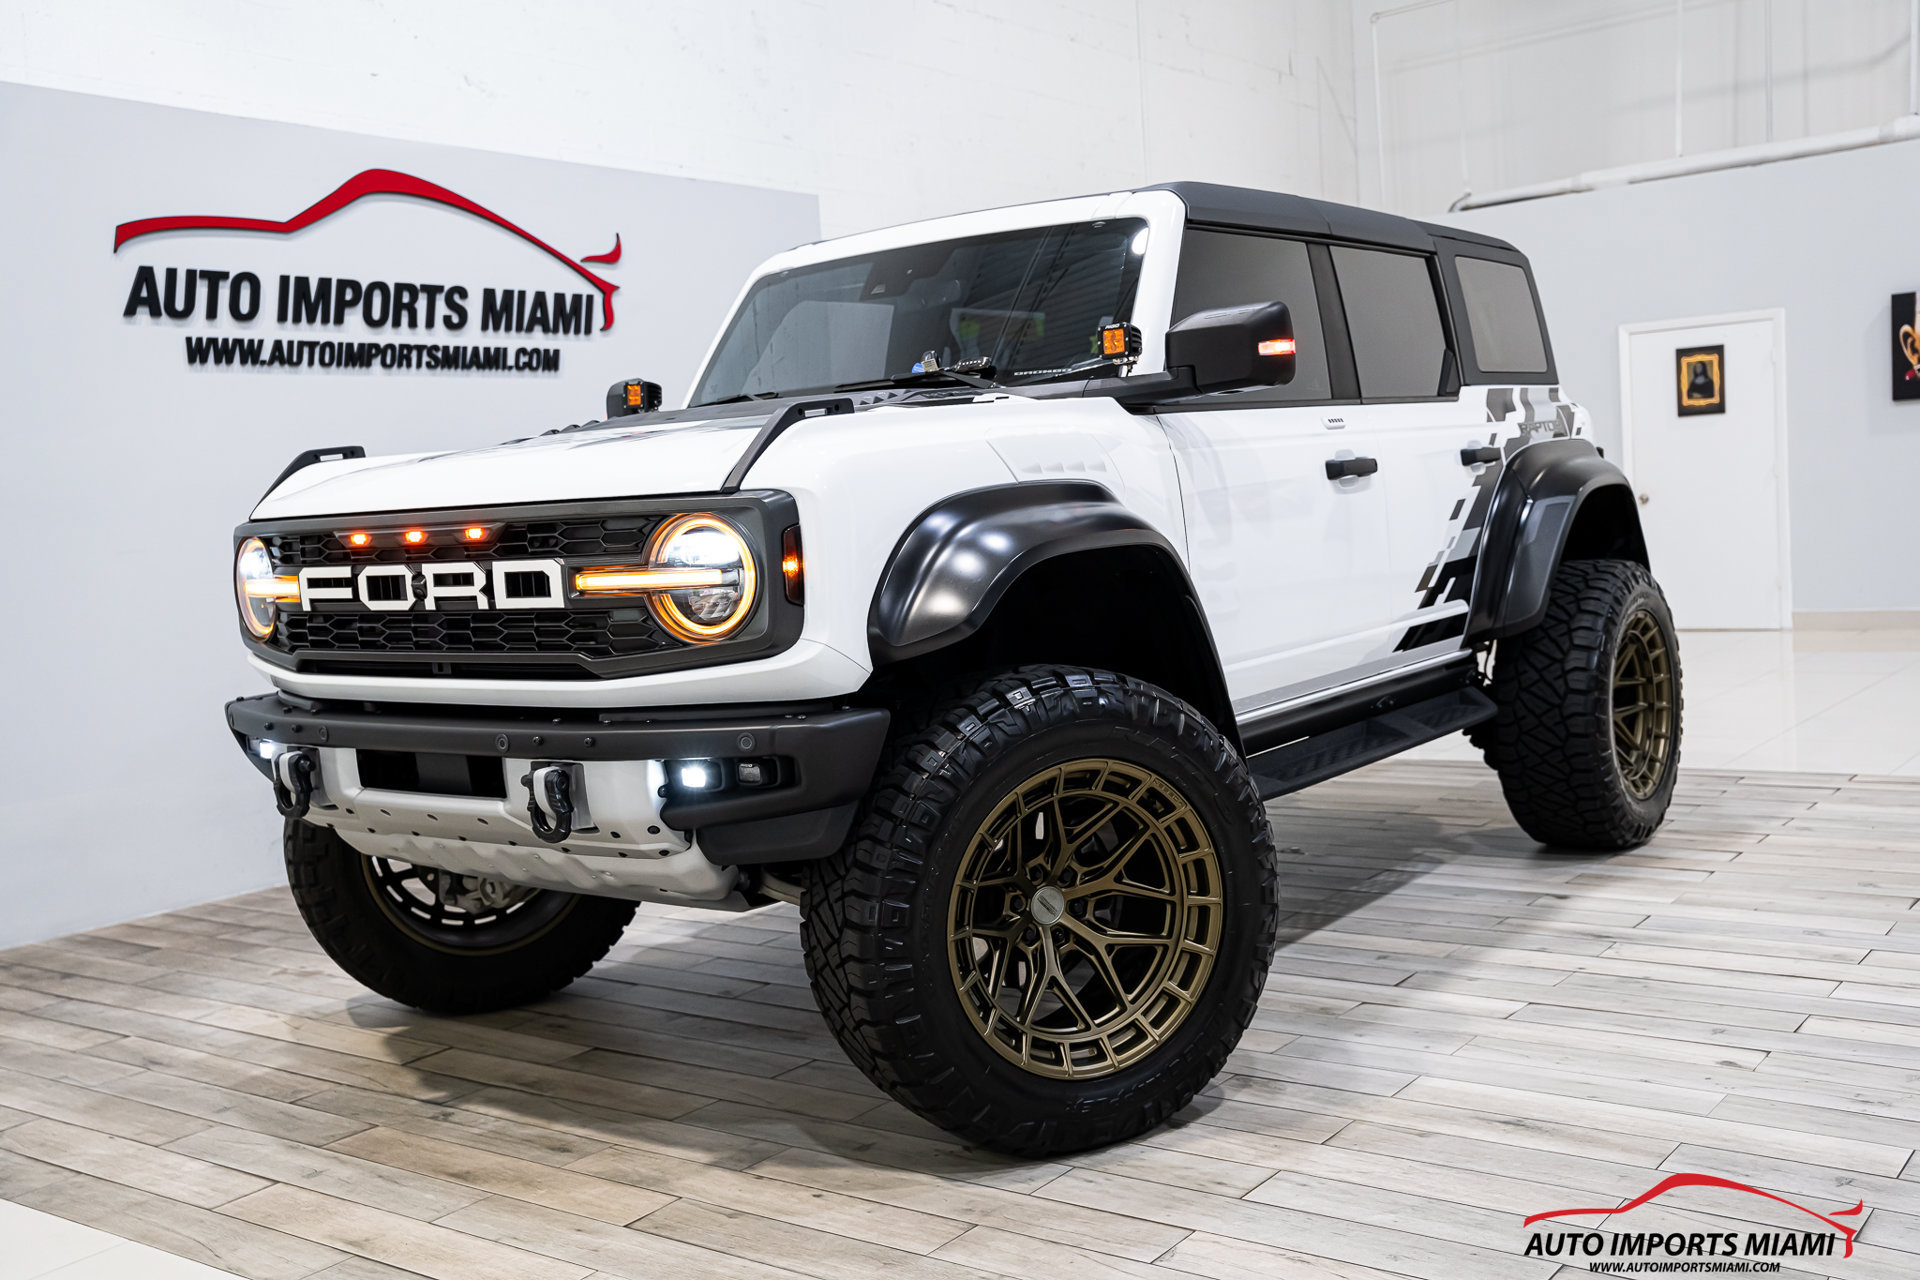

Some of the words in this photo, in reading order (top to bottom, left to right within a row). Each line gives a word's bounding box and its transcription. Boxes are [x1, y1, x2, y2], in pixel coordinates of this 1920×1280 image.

[124, 265, 261, 323] AUTO
[277, 274, 469, 331] IMPORTS
[480, 288, 595, 336] MIAMI
[186, 336, 560, 373] WWW.AUTOIMPORTSMIAMI.COM
[298, 558, 565, 611] FORD
